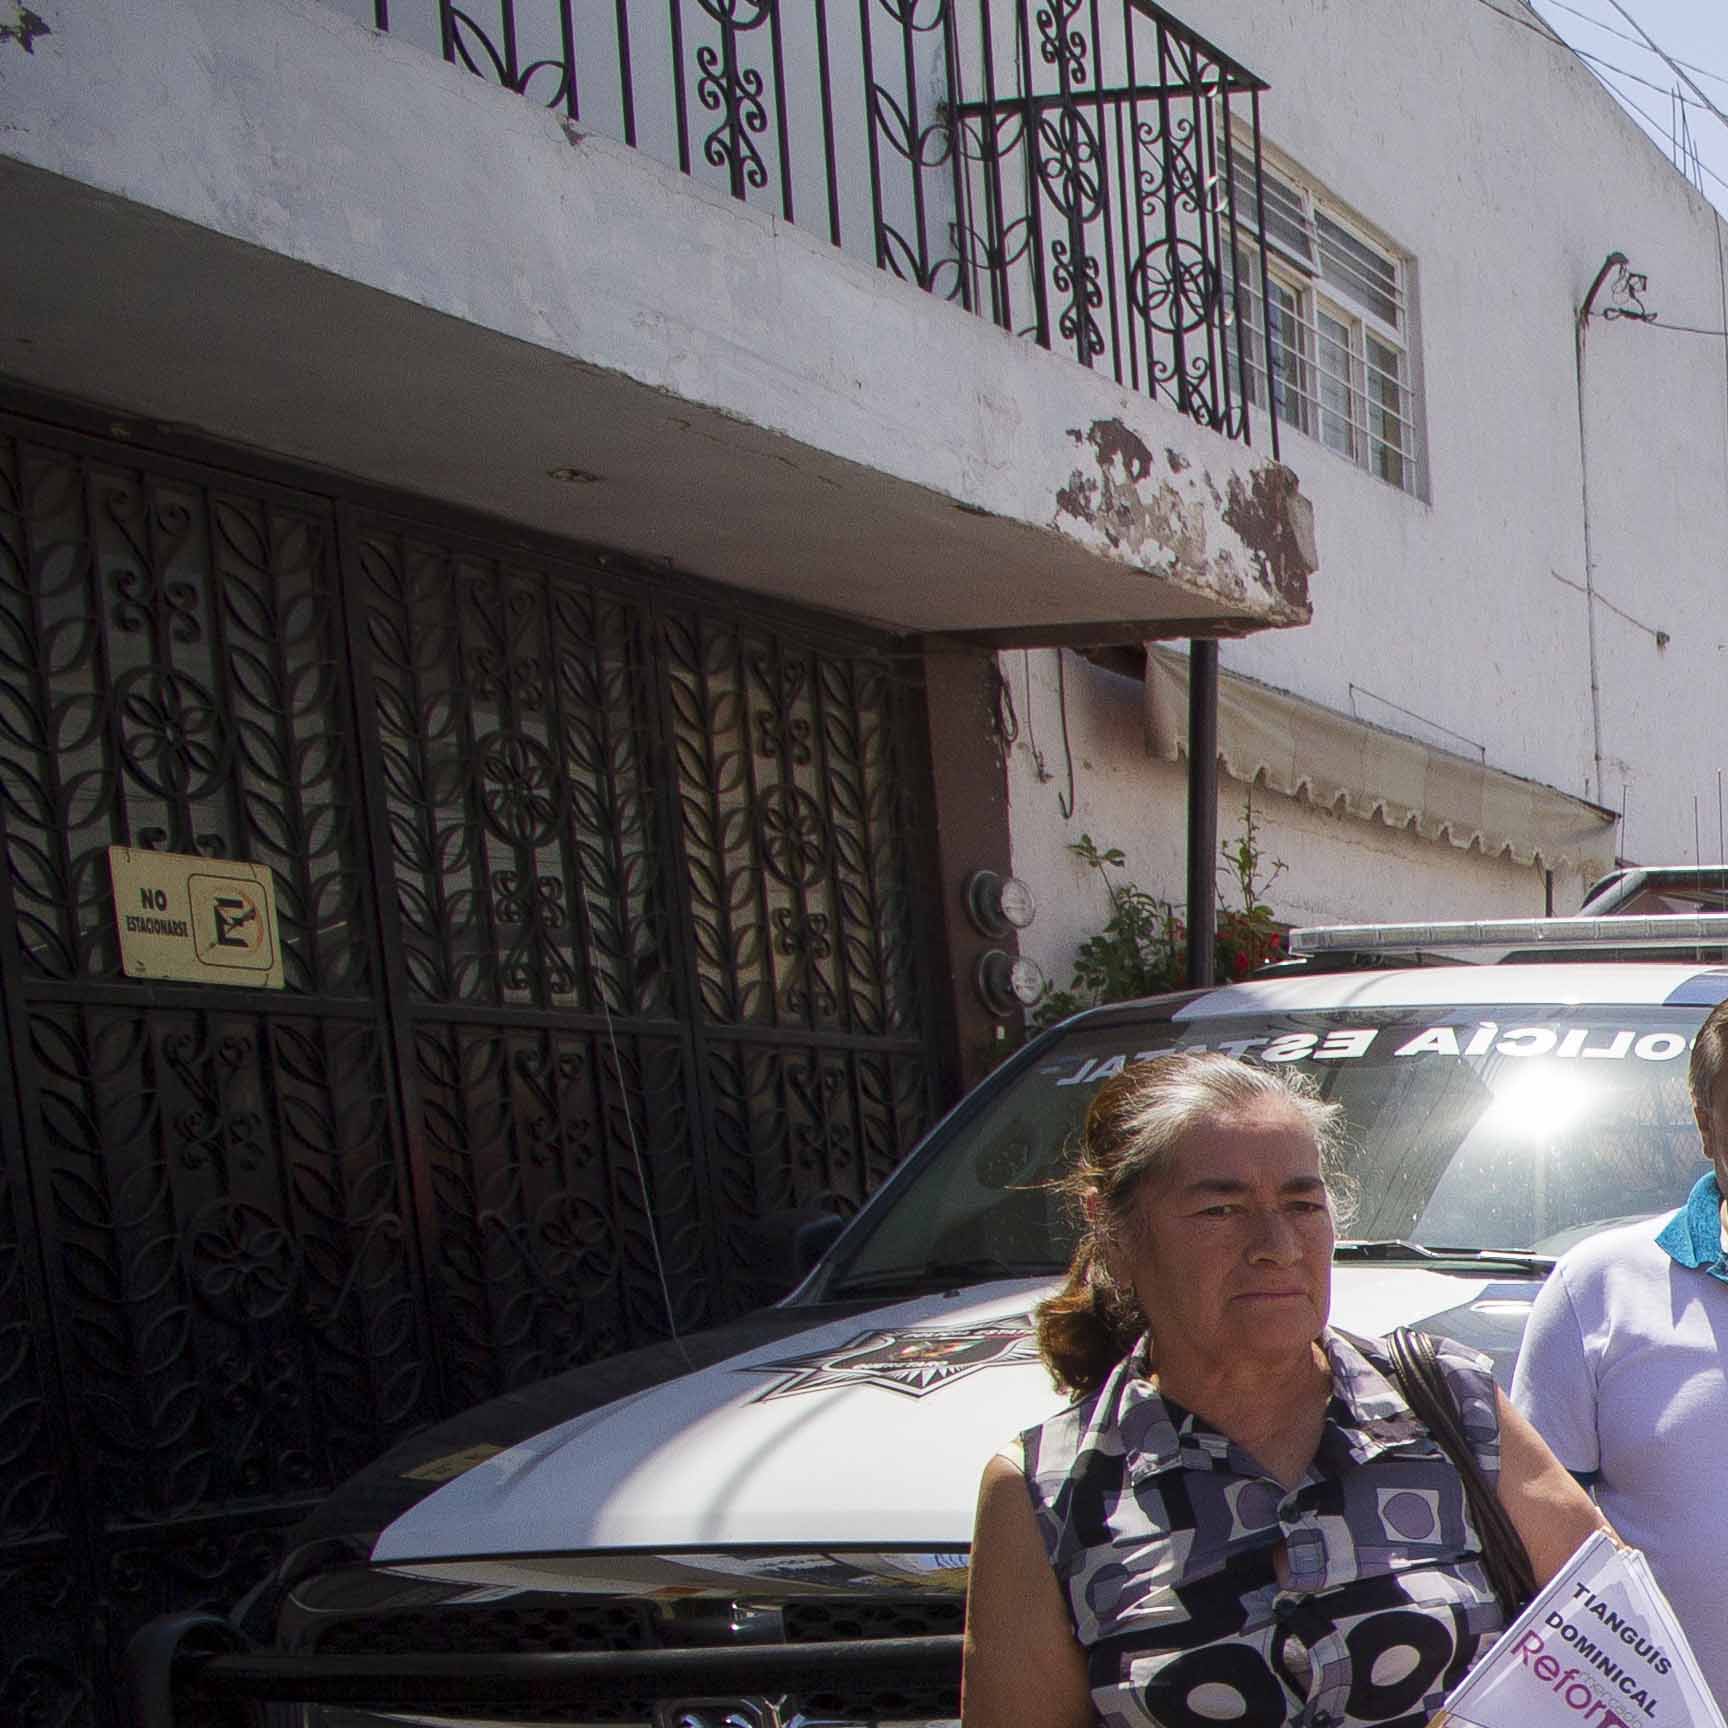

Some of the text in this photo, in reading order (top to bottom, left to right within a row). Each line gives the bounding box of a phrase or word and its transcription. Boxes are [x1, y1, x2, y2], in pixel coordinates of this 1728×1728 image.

[126, 915, 188, 938] ESTACIONARSE
[140, 888, 168, 912] NO
[1573, 1582, 1673, 1676] TIANGUIS
[1545, 1611, 1656, 1719] DOMINICAL
